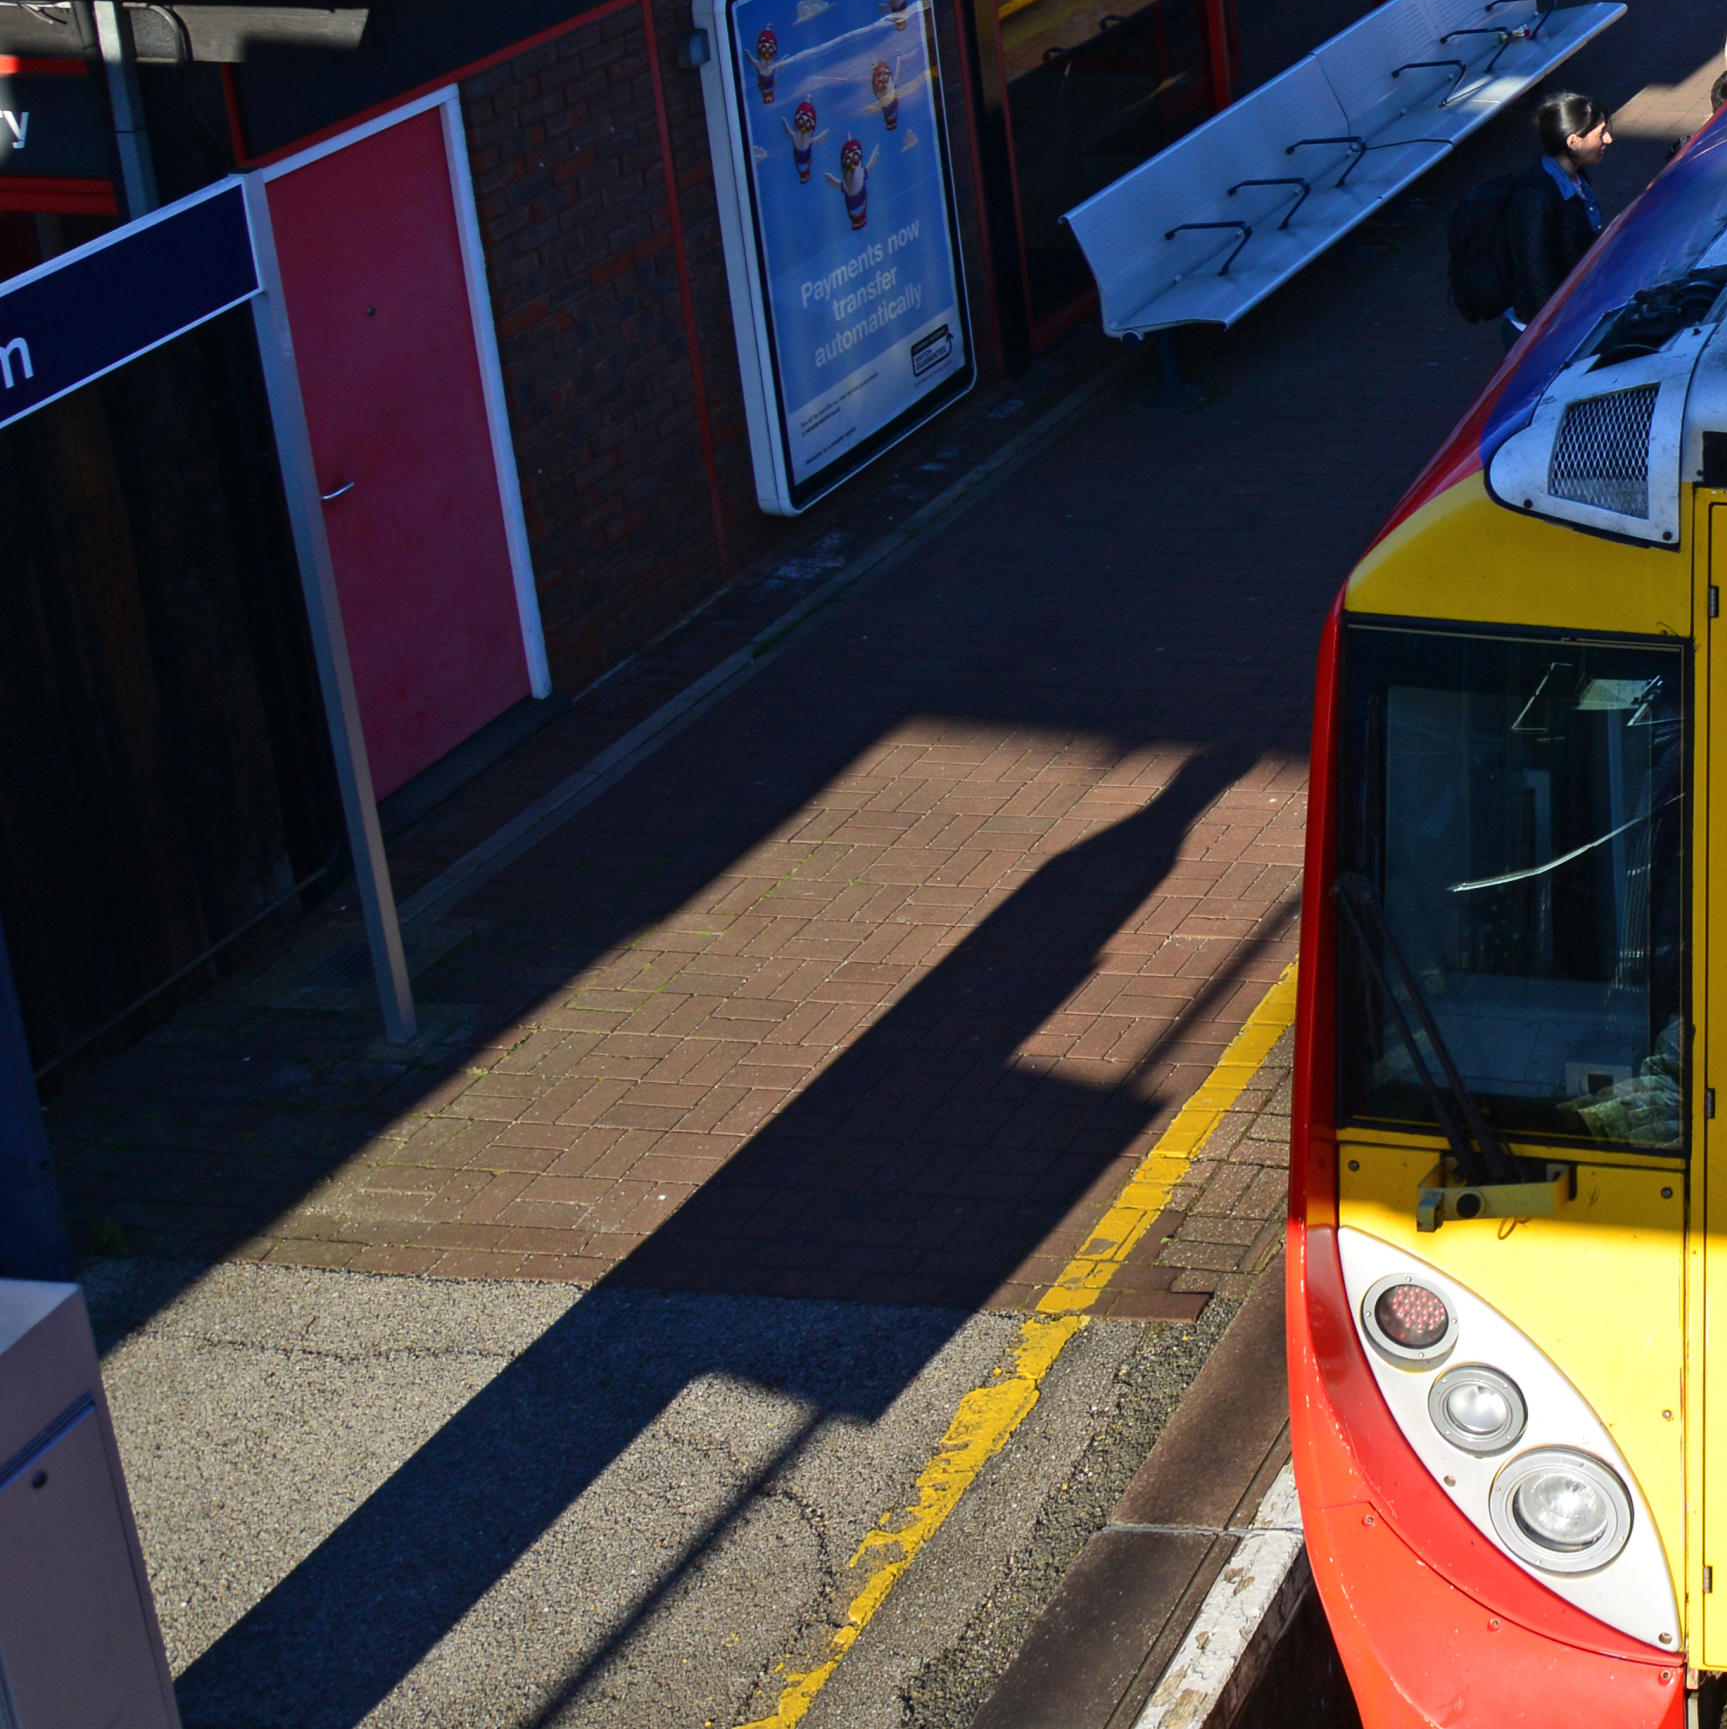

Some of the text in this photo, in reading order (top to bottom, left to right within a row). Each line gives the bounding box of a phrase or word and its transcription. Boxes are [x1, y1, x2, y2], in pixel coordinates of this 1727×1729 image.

[801, 220, 920, 309] Payments now
[832, 266, 898, 322] transfer
[815, 283, 922, 368] automatically
